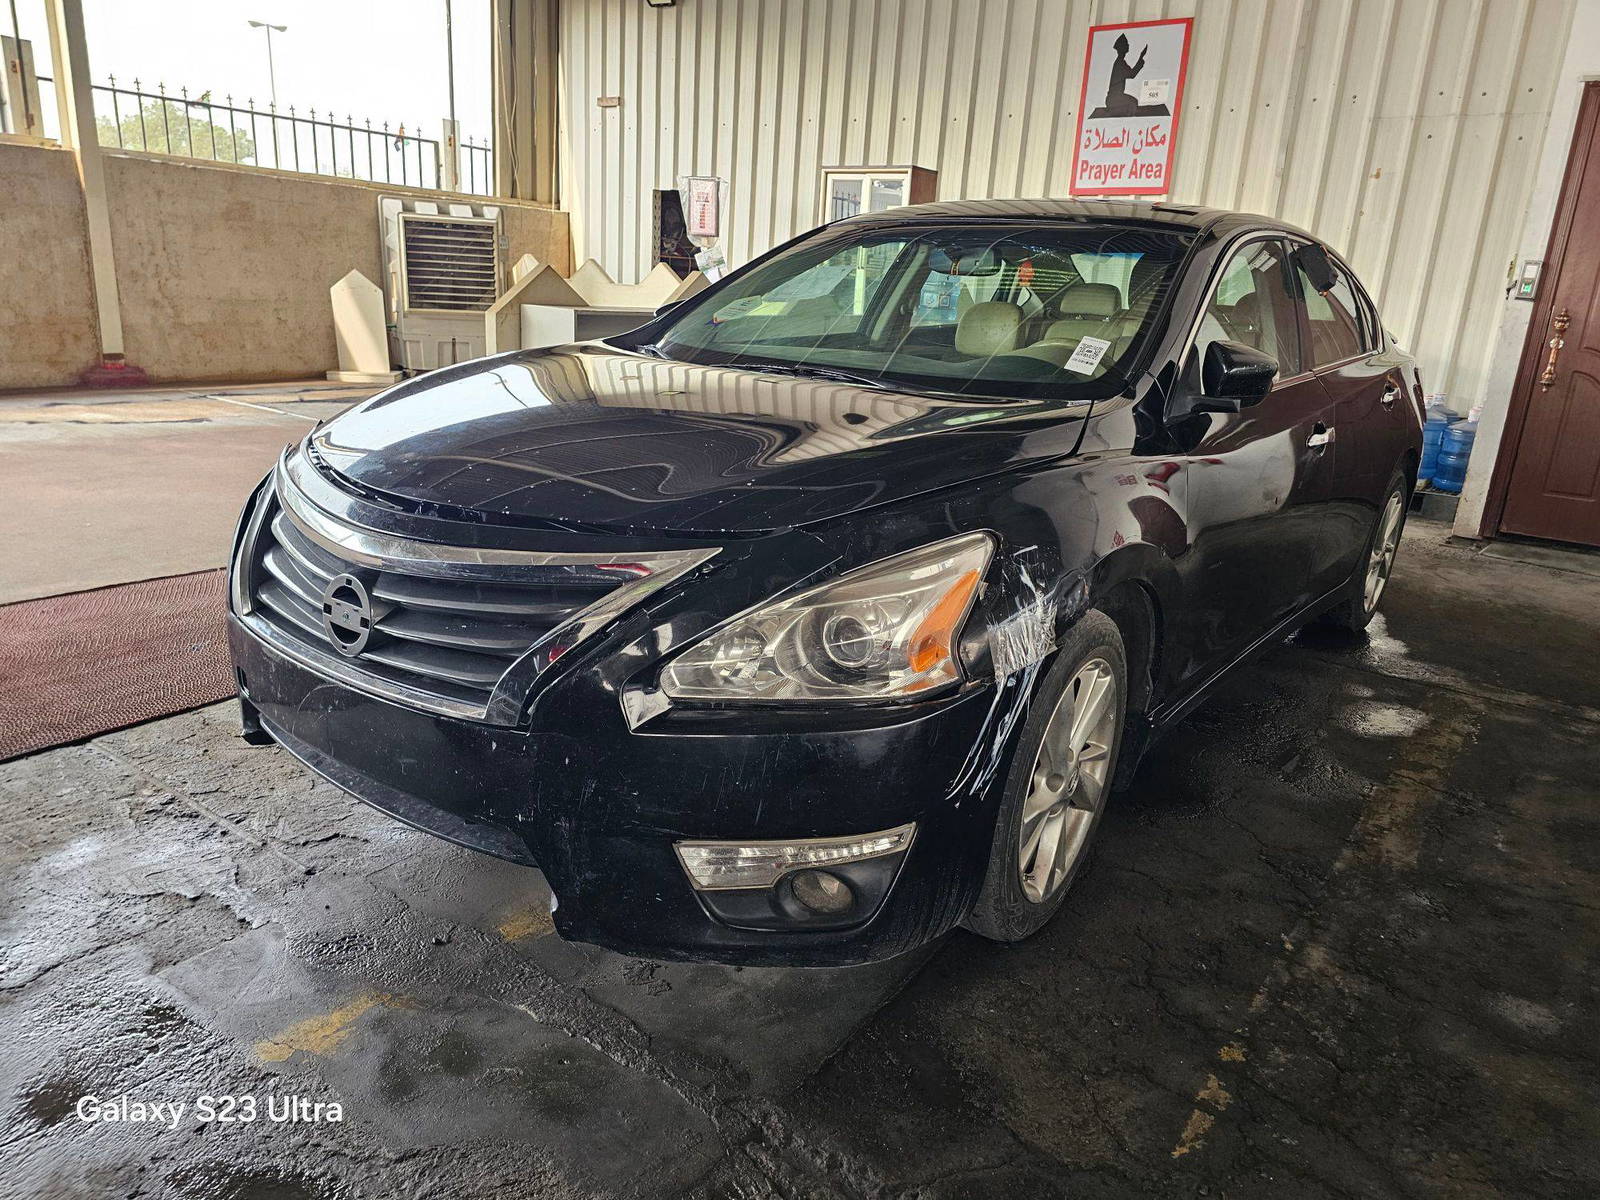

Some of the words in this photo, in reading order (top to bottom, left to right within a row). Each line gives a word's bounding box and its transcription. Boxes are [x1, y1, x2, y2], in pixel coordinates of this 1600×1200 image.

[1084, 127, 1130, 151] الصلاة
[1132, 124, 1167, 154] مكان
[1080, 159, 1126, 185] Prayer
[1128, 158, 1163, 179] Area
